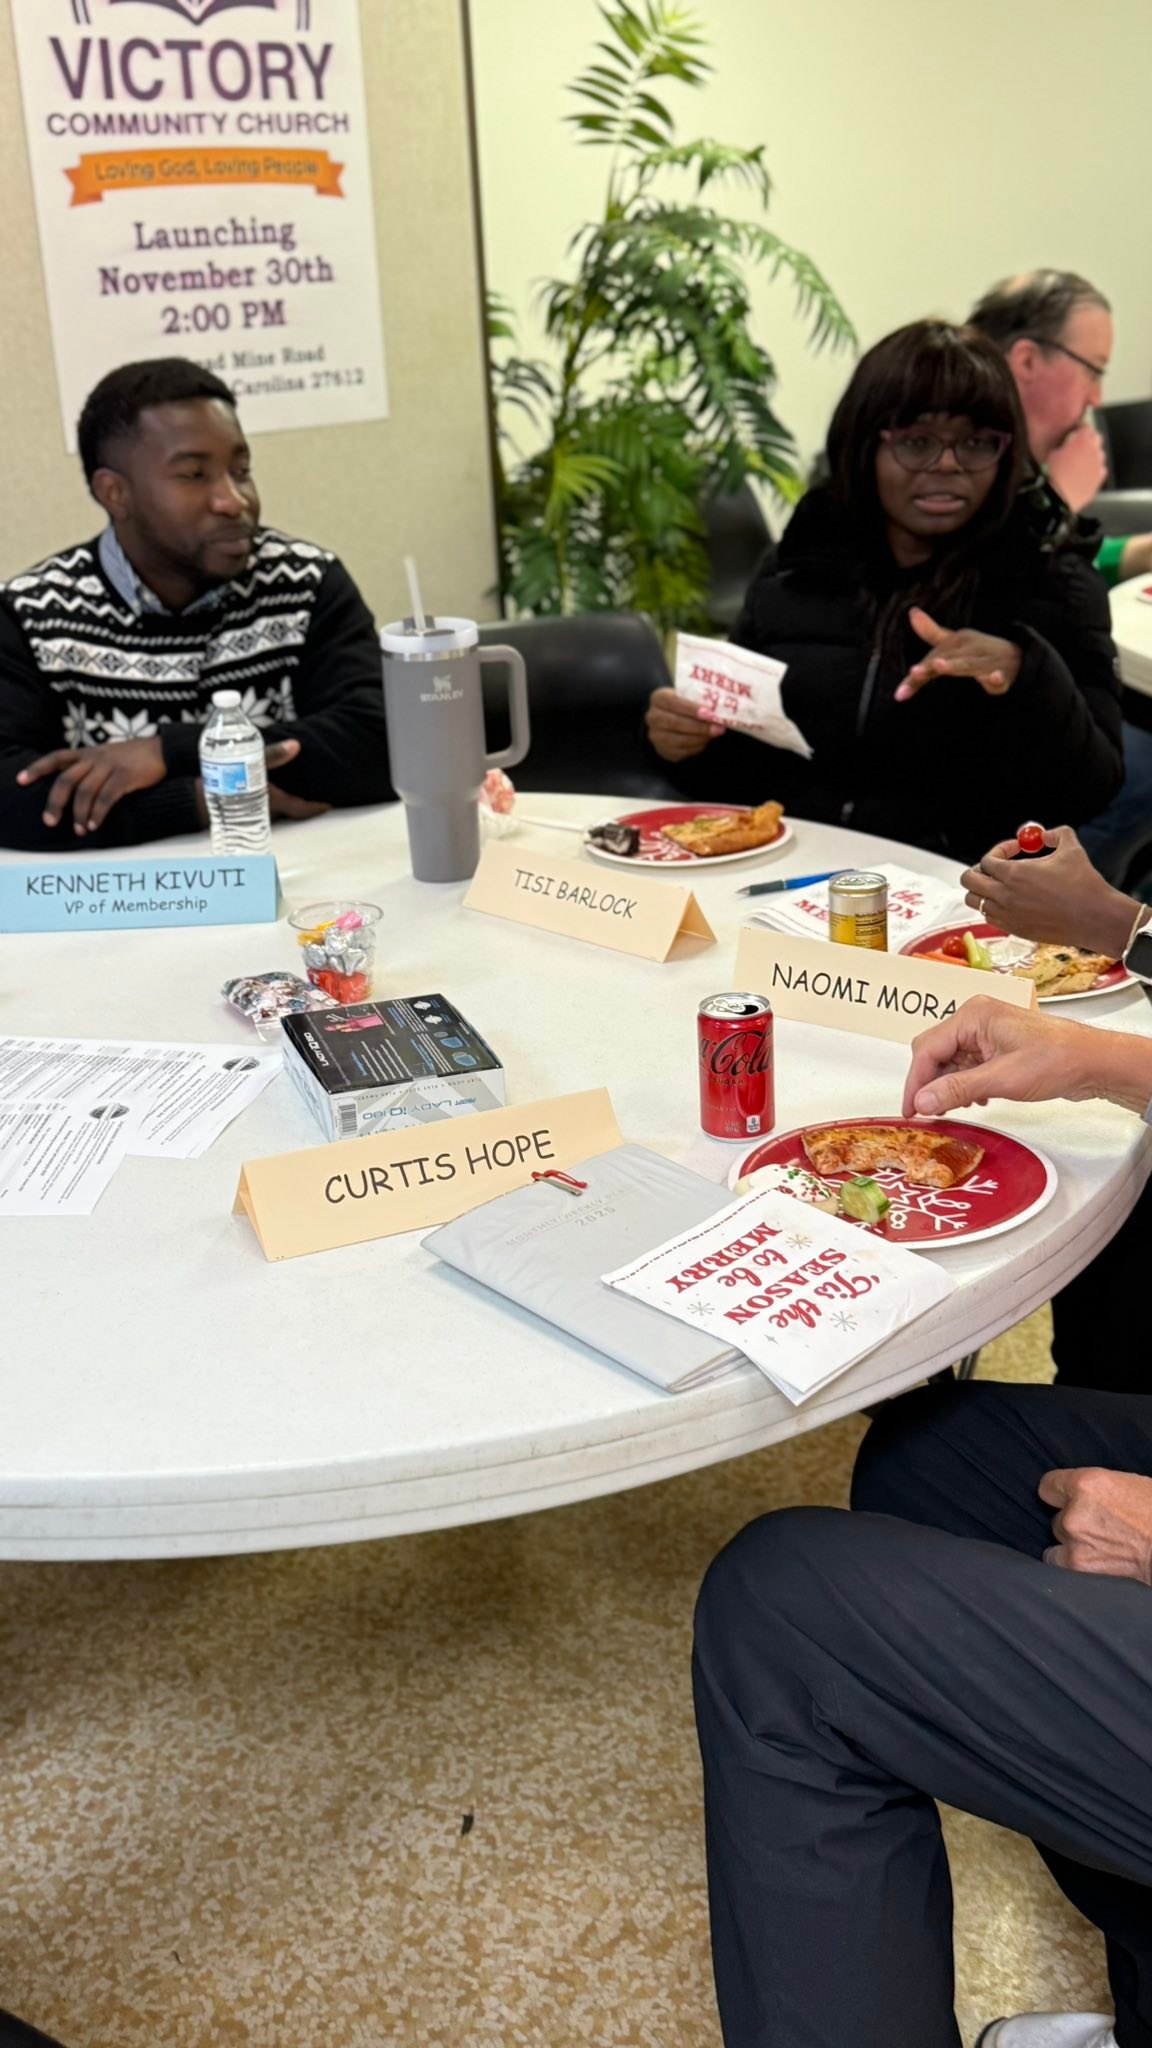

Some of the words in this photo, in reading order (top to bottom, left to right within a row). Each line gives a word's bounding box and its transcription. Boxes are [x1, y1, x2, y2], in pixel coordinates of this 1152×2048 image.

[50, 37, 333, 101] VICTORY
[47, 113, 228, 136] COMMUNITY
[237, 112, 350, 134] CHURCH
[95, 159, 154, 181] Loving
[203, 156, 260, 177] Loving
[263, 156, 318, 175] People
[133, 217, 297, 251] Launching
[98, 264, 256, 296] November
[266, 257, 335, 285] 30th
[161, 305, 230, 334] 2:00
[243, 300, 286, 328] PM
[282, 346, 325, 363] Road
[26, 871, 146, 896] KENNETH
[155, 868, 245, 891] KIVUTI
[514, 868, 555, 896] TISI
[556, 880, 638, 919] BARLOCK
[65, 899, 85, 914] VP
[89, 899, 107, 914] of
[111, 896, 208, 913] Membership
[772, 962, 871, 1004] NAOMI
[325, 1153, 456, 1204] CURTIS
[465, 1129, 555, 1175] HOPE
[665, 1221, 783, 1294] MERRY
[752, 1248, 788, 1267] to
[717, 1267, 762, 1287] be
[723, 1248, 847, 1325] SEASON
[814, 1271, 880, 1299] 'Tis
[768, 1298, 822, 1329] the
